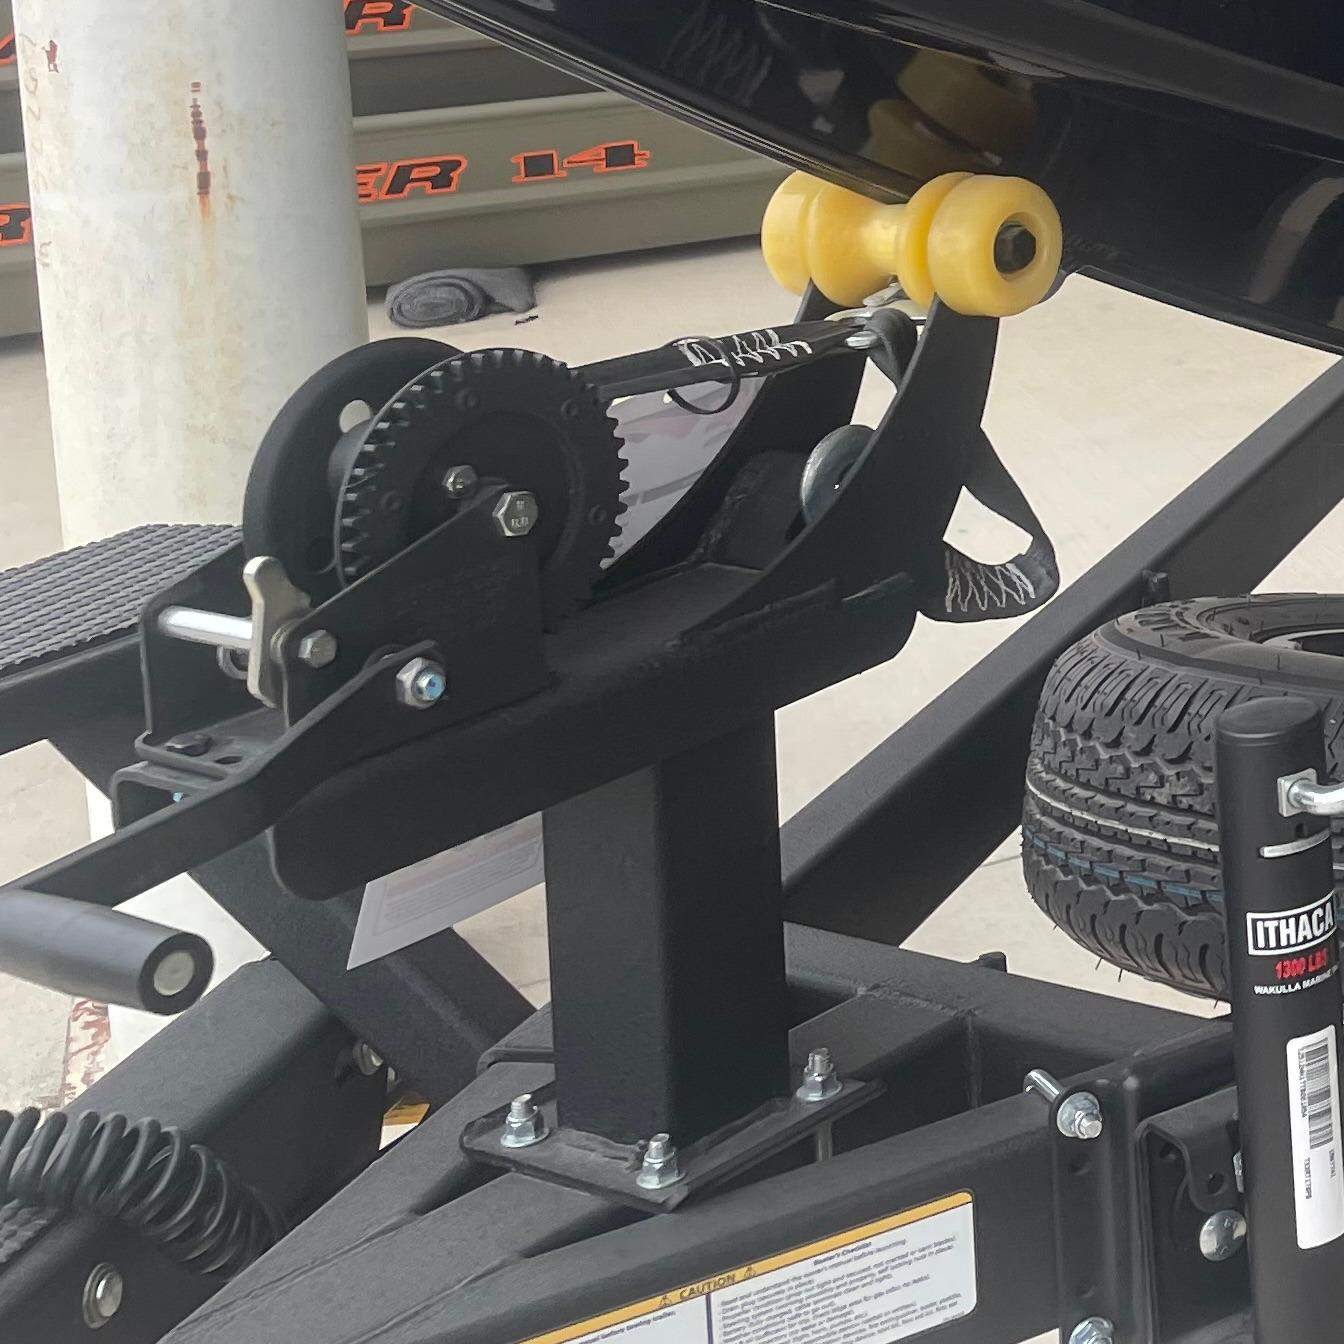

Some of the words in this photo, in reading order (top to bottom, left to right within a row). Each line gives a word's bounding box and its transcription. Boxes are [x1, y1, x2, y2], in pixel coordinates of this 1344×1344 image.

[511, 140, 650, 183] 14
[1256, 902, 1334, 948] ITHACA
[1275, 957, 1306, 980] 1300
[1254, 982, 1301, 995] WAKULLA
[680, 1274, 735, 1300] CAUTION
